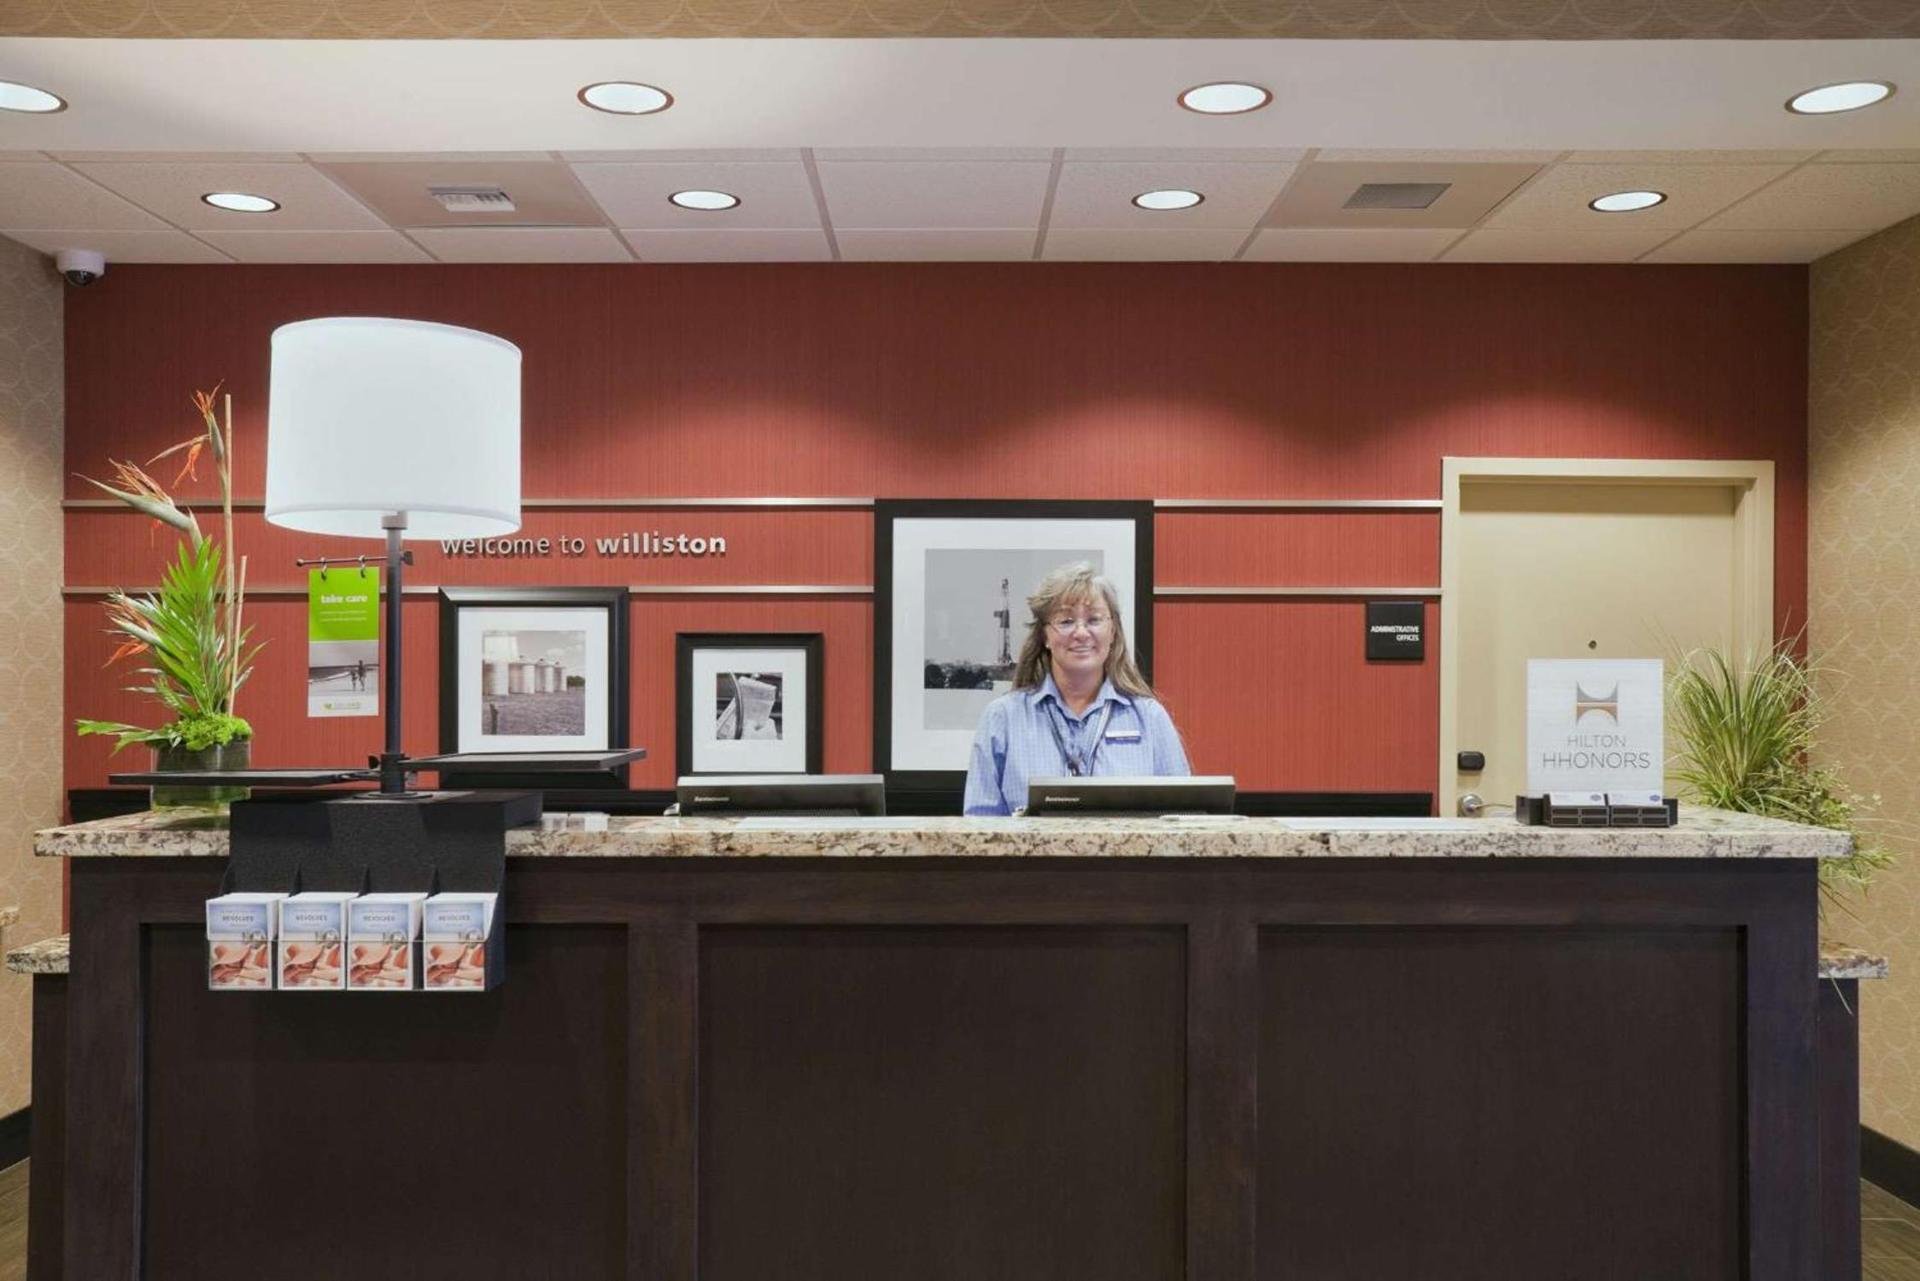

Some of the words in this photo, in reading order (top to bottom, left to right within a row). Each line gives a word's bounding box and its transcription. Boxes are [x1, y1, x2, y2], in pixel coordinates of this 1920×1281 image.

[440, 536, 550, 555] welcome
[558, 534, 585, 555] to
[595, 530, 727, 555] williston
[1370, 625, 1420, 633] ADMINISTRATIVE
[1396, 634, 1420, 642] OFFICES
[1567, 734, 1627, 748] HILTON
[1542, 751, 1651, 769] HHONORS
